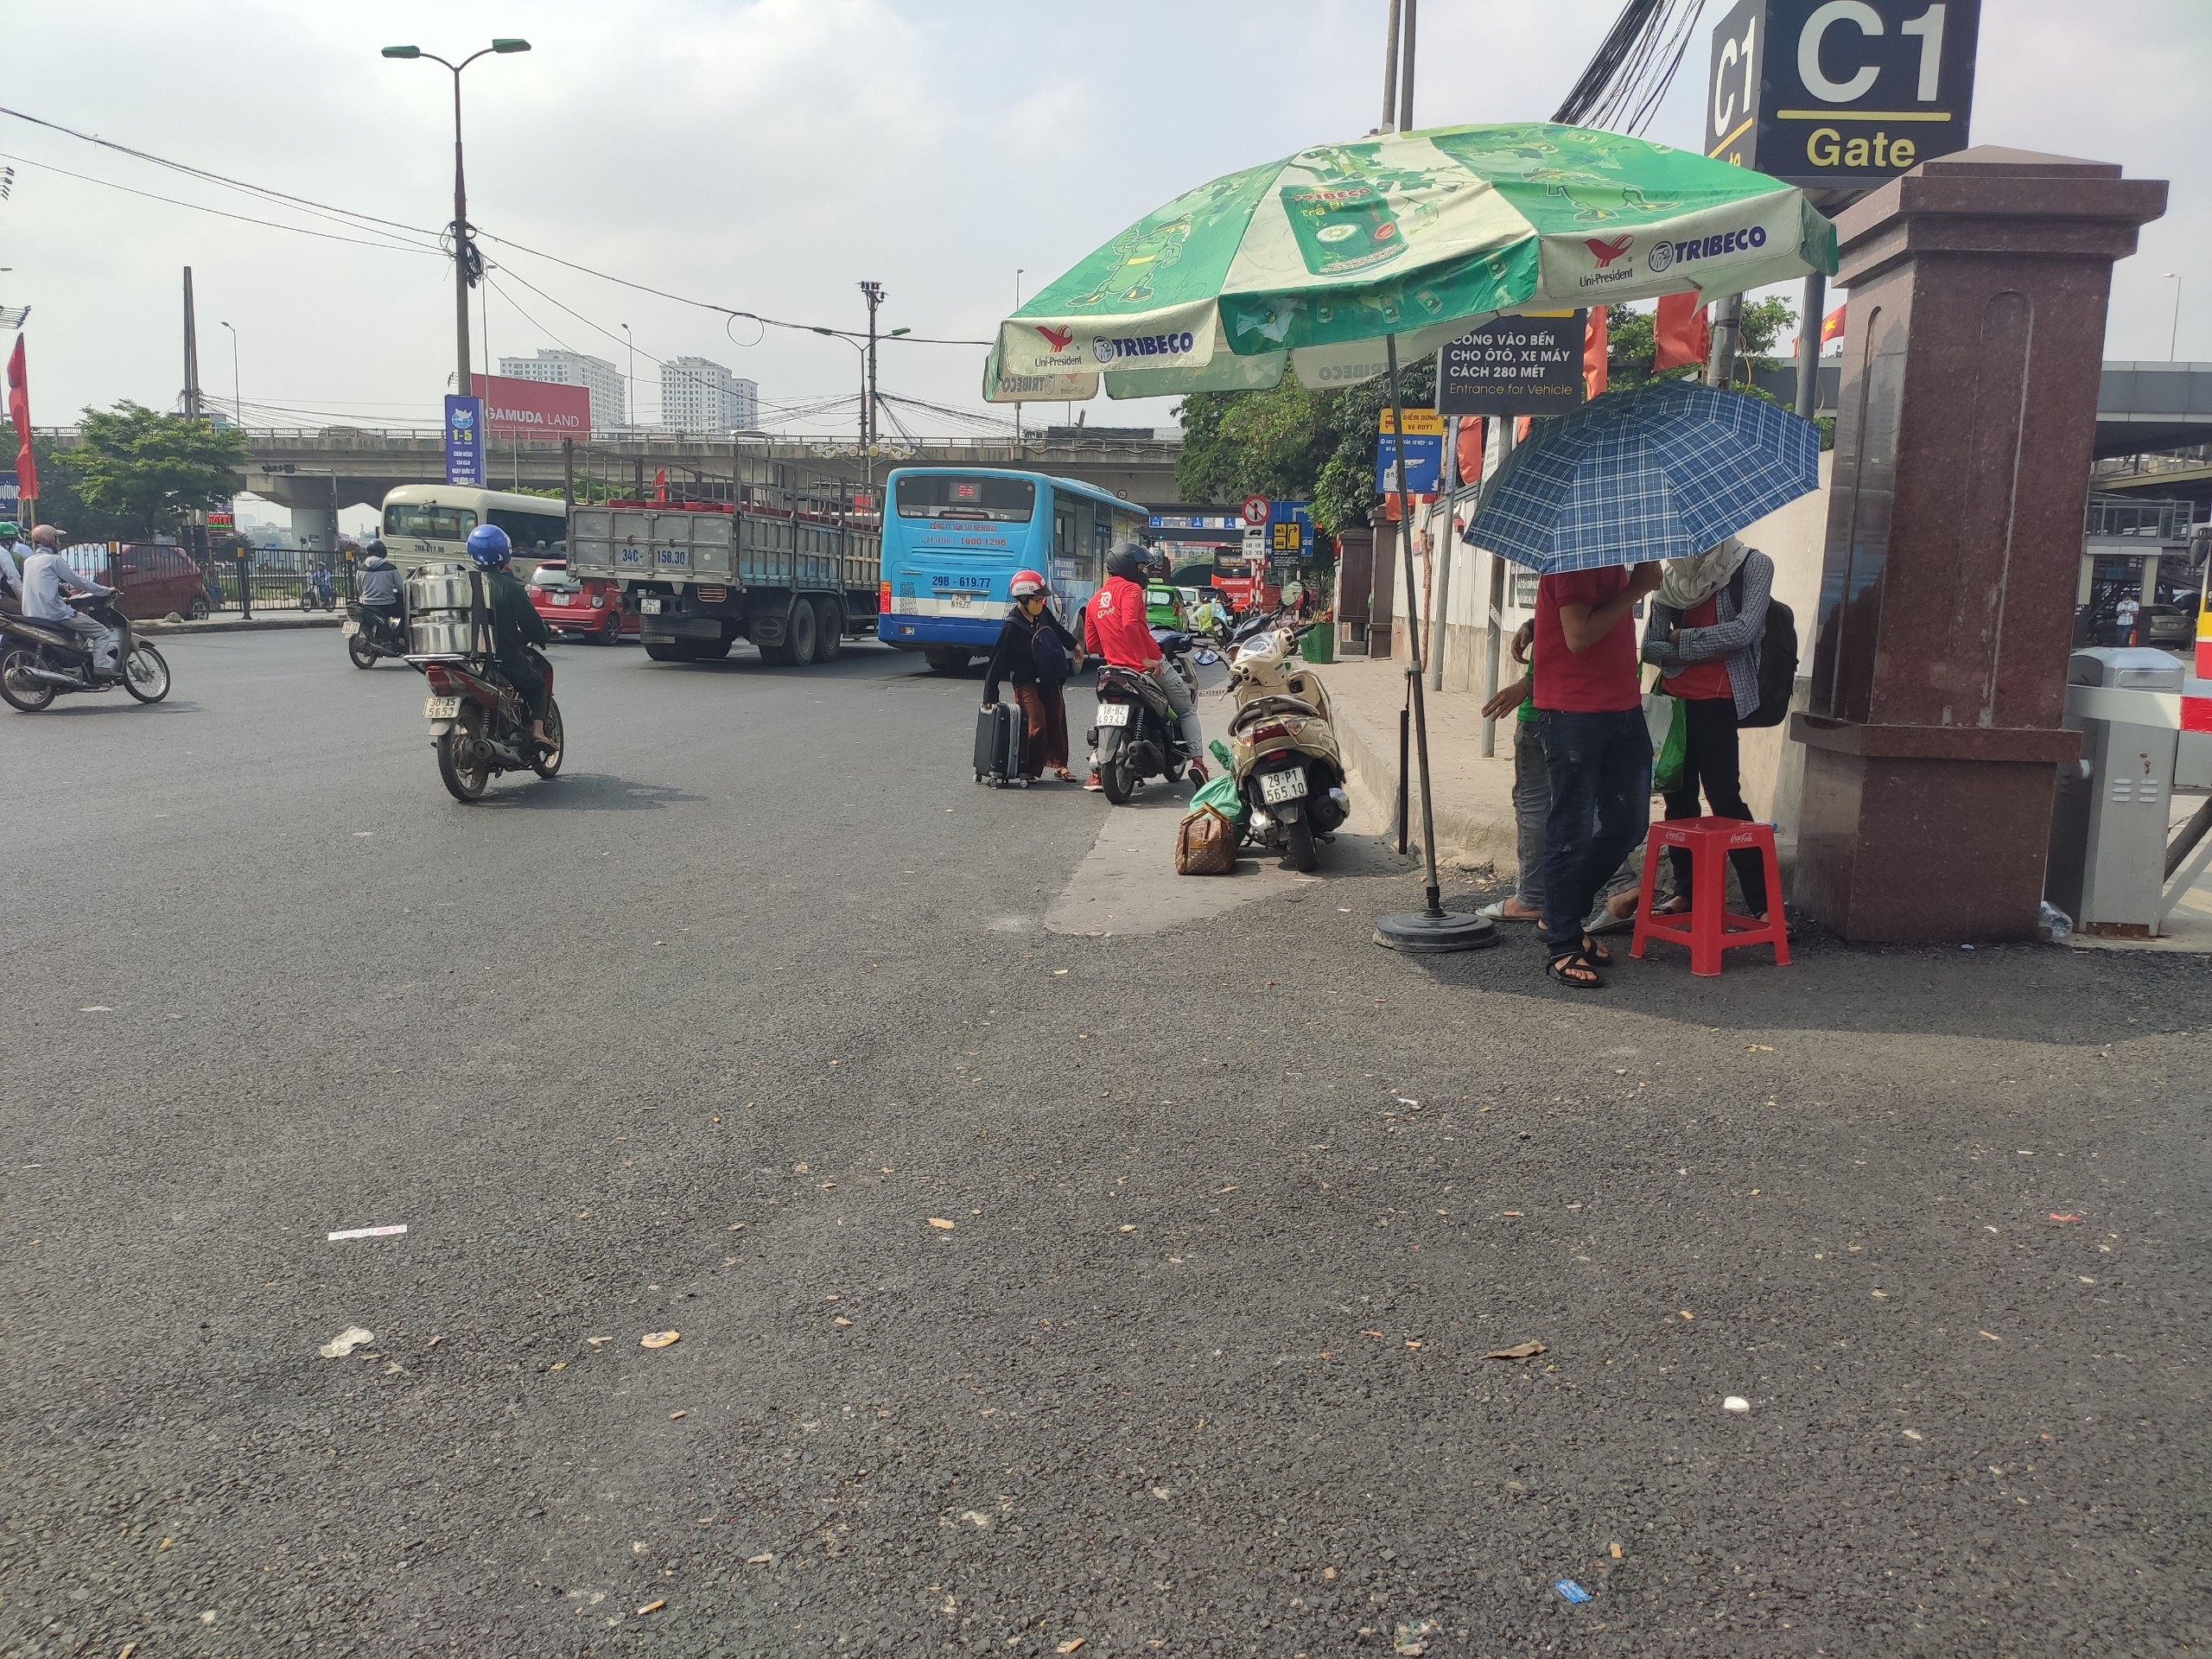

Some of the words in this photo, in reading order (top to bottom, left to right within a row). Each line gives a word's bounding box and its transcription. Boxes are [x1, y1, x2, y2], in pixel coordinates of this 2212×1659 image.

[1797, 0, 1946, 103] C1
[1714, 16, 1756, 137] C1
[1807, 128, 1916, 168] Gate
[1675, 226, 1766, 263] TRIBECO
[1580, 268, 1633, 288] Uni-President
[1111, 332, 1193, 358] TRIBECO
[1497, 332, 1526, 346] VÀO
[1530, 331, 1554, 346] BẾN
[1034, 355, 1082, 368] Uni-President
[1451, 350, 1481, 361] CHO
[1520, 351, 1536, 361] XE
[1541, 348, 1570, 361] MÁY
[1450, 363, 1489, 378] CÁCH
[1493, 367, 1516, 378] 280
[1521, 364, 1545, 378] MÉT
[1450, 384, 1503, 394] Entrance
[1508, 383, 1524, 394] for
[1528, 384, 1572, 395] Vehicle
[486, 407, 543, 424] GAMUDA
[548, 413, 580, 428] LAND
[453, 429, 473, 442] 1-5
[657, 550, 685, 565] 158.30
[932, 575, 950, 586] 29B
[960, 577, 991, 588] 619.77
[428, 708, 454, 717] 5653
[1268, 769, 1297, 788] 29-P1
[1266, 782, 1305, 802] 565.10
